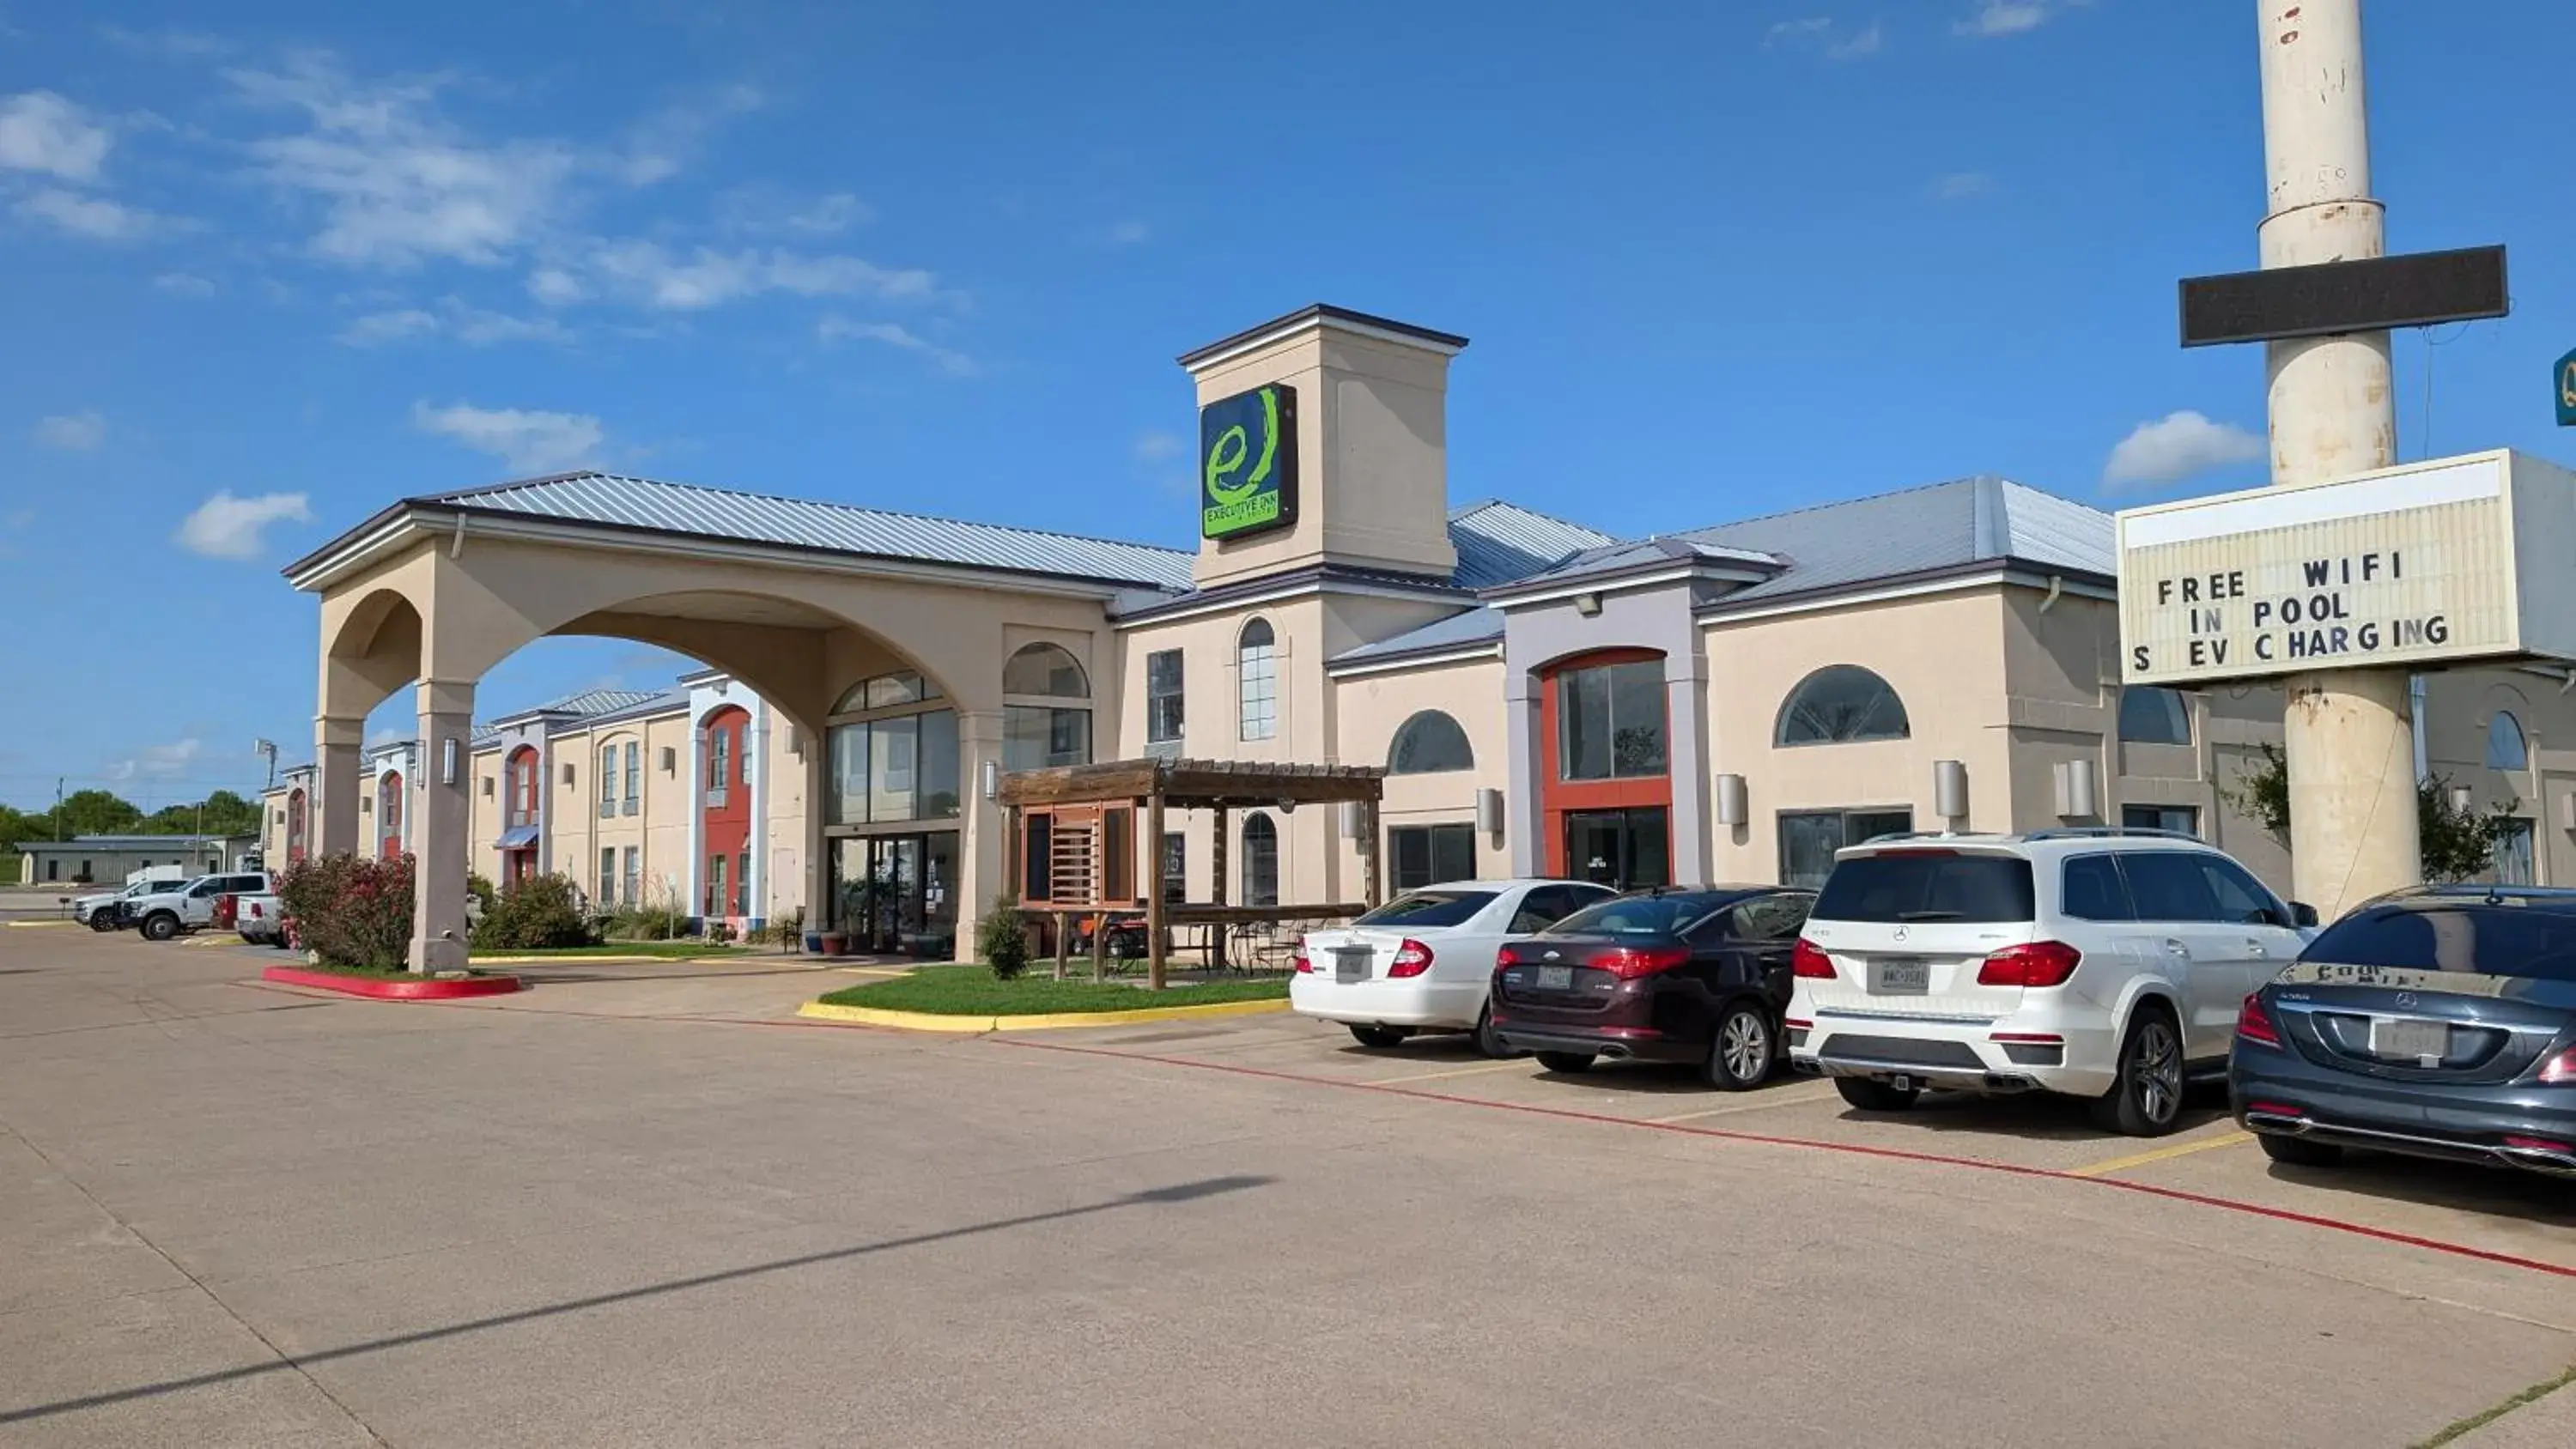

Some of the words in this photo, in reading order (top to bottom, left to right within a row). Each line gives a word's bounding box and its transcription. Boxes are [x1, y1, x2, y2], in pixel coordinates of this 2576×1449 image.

[1207, 500, 1257, 522] EXECUTIVE
[1260, 494, 1277, 512] INN
[2158, 571, 2245, 604] FREE
[2303, 551, 2401, 587] WIFI
[2190, 608, 2222, 634] IN
[2254, 593, 2349, 627] POOL
[2134, 646, 2150, 670] S
[2190, 639, 2228, 666] EV
[2254, 615, 2447, 660] CHARGING
